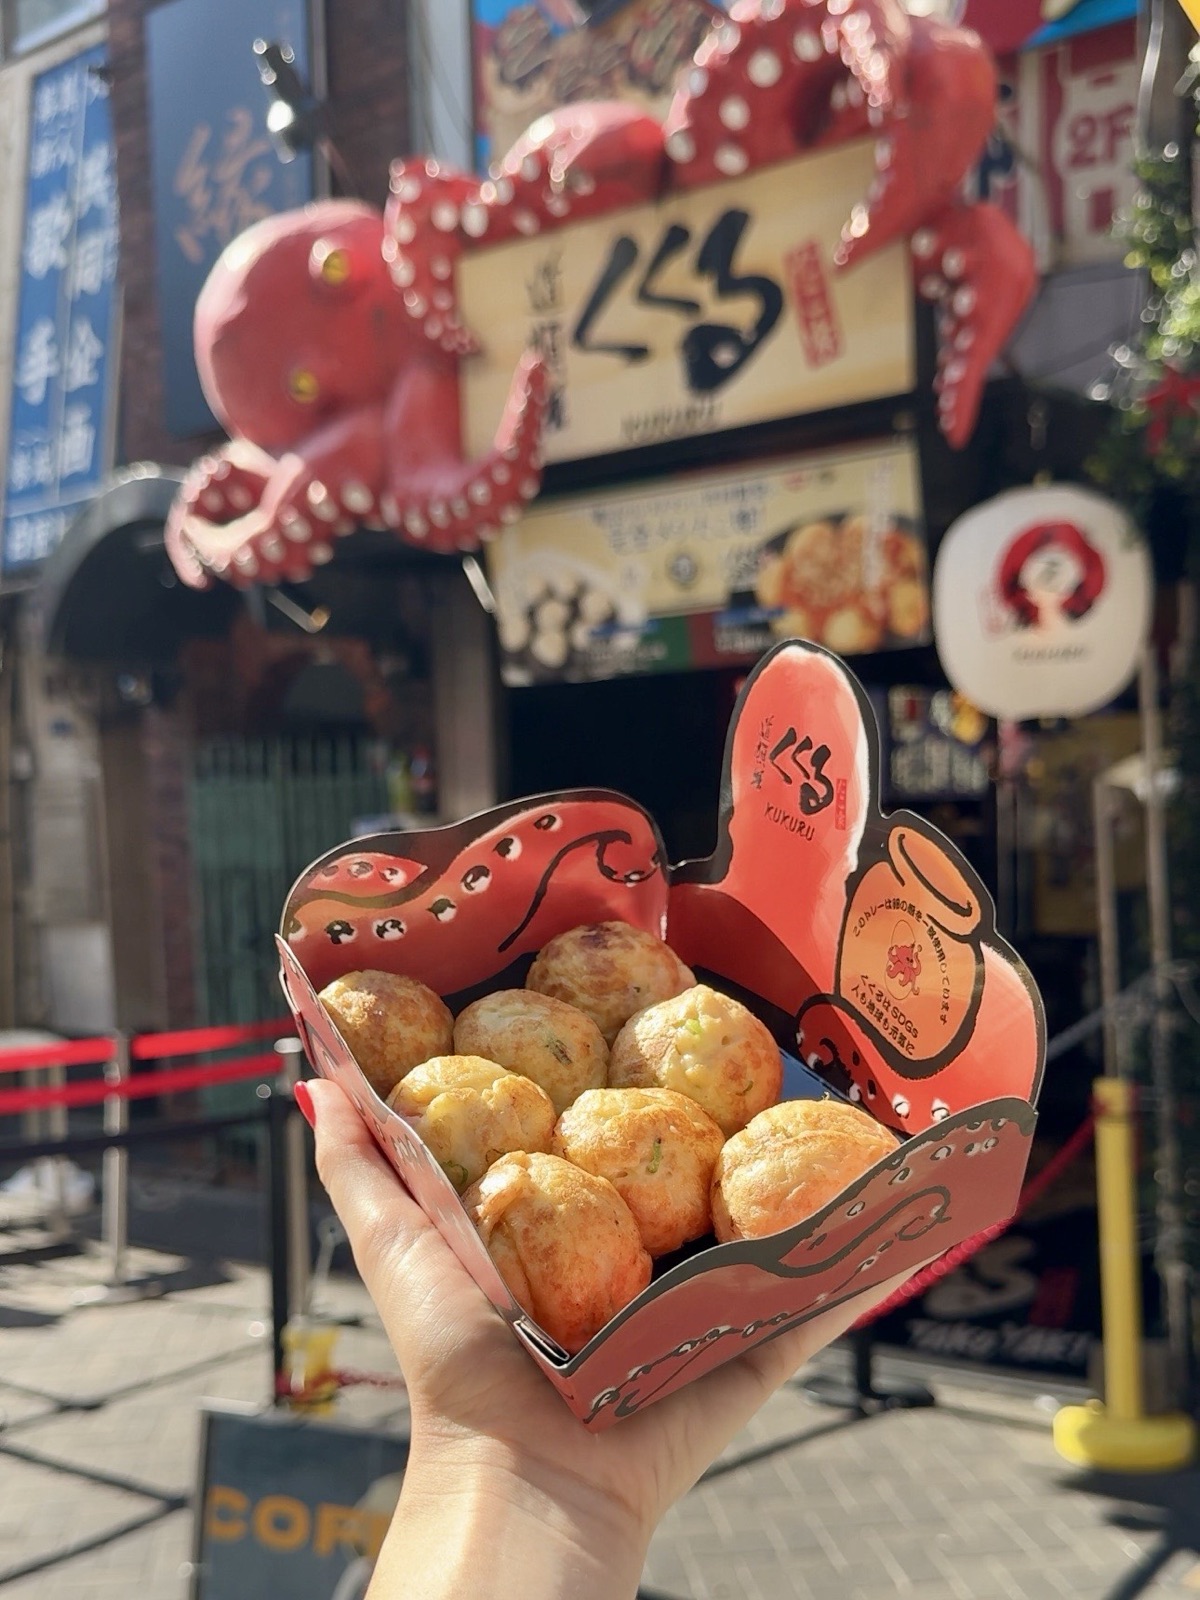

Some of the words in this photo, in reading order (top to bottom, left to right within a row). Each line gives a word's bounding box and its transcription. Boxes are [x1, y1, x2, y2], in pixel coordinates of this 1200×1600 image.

[571, 209, 784, 394] くくる
[769, 727, 834, 816] くくる
[764, 802, 816, 841] KUKURU
